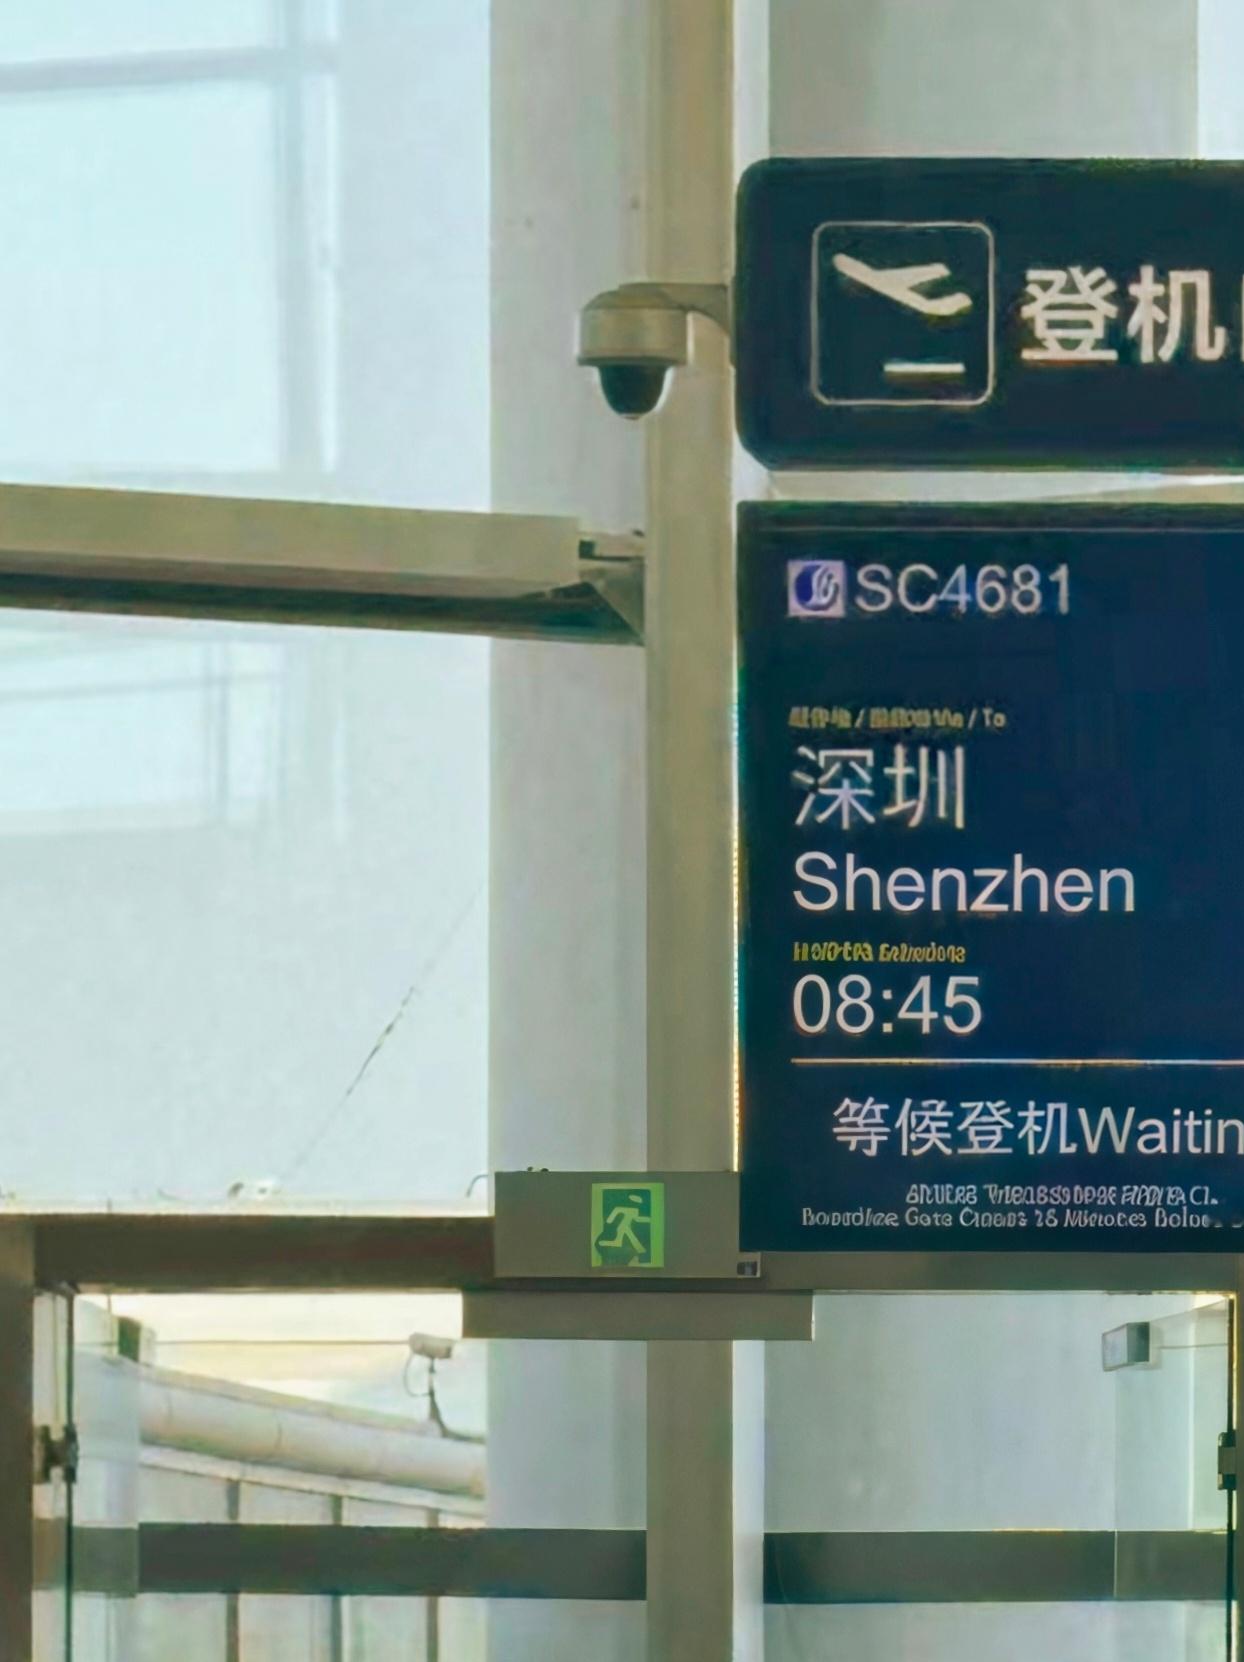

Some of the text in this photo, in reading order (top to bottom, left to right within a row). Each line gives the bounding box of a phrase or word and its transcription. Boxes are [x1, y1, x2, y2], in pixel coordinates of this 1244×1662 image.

[855, 562, 1072, 615] SC4681
[791, 744, 966, 830] 深圳
[792, 851, 1136, 914] Shenzhen
[792, 972, 983, 1036] 08:45
